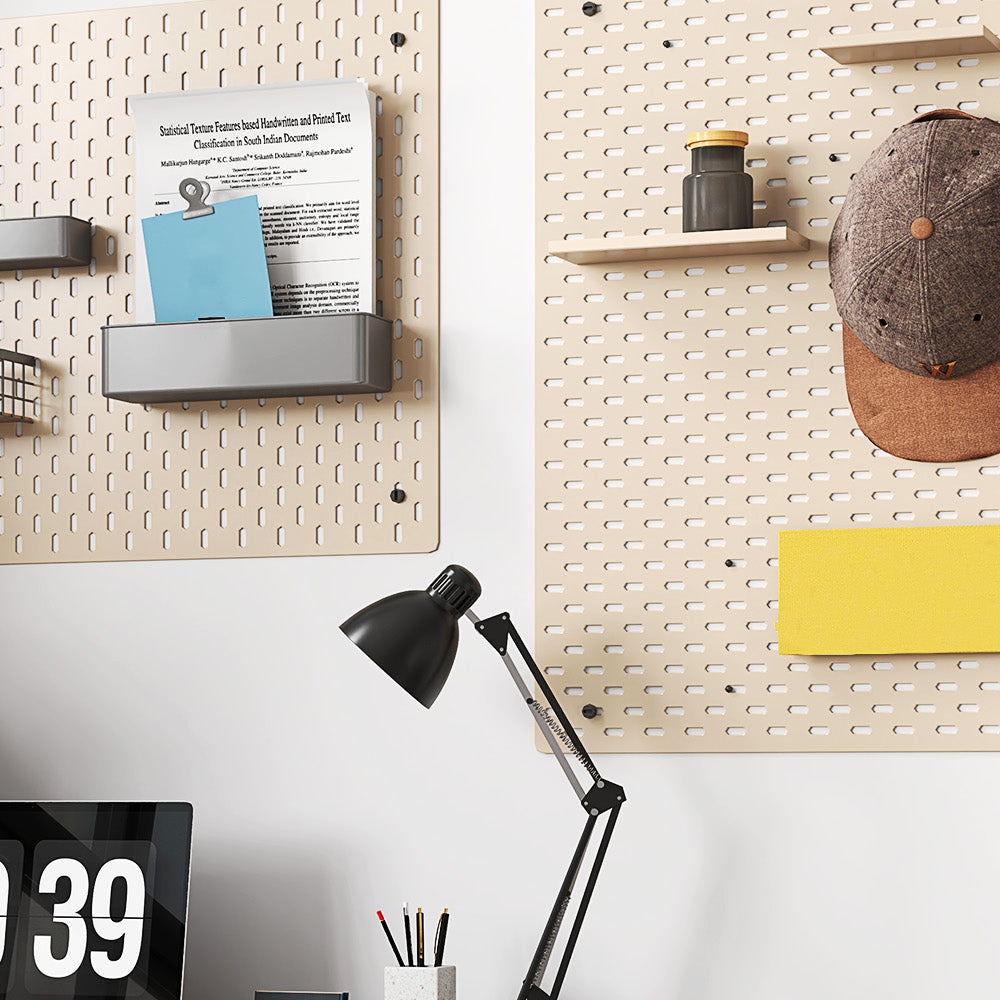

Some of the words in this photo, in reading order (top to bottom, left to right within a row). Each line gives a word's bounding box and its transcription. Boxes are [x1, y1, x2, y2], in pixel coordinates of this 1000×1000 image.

[160, 124, 189, 136] Statistical
[190, 123, 214, 134] Texture
[215, 121, 242, 132] Features
[241, 118, 259, 130] based
[260, 116, 298, 128] Handwritten
[300, 114, 311, 126] and
[312, 113, 335, 125] Printed
[336, 112, 351, 123] Text
[194, 138, 236, 149] Classification
[236, 137, 242, 146] in
[244, 136, 261, 145] South
[263, 134, 282, 144] Indian
[284, 133, 318, 142] Documents
[33, 857, 146, 979] 39
